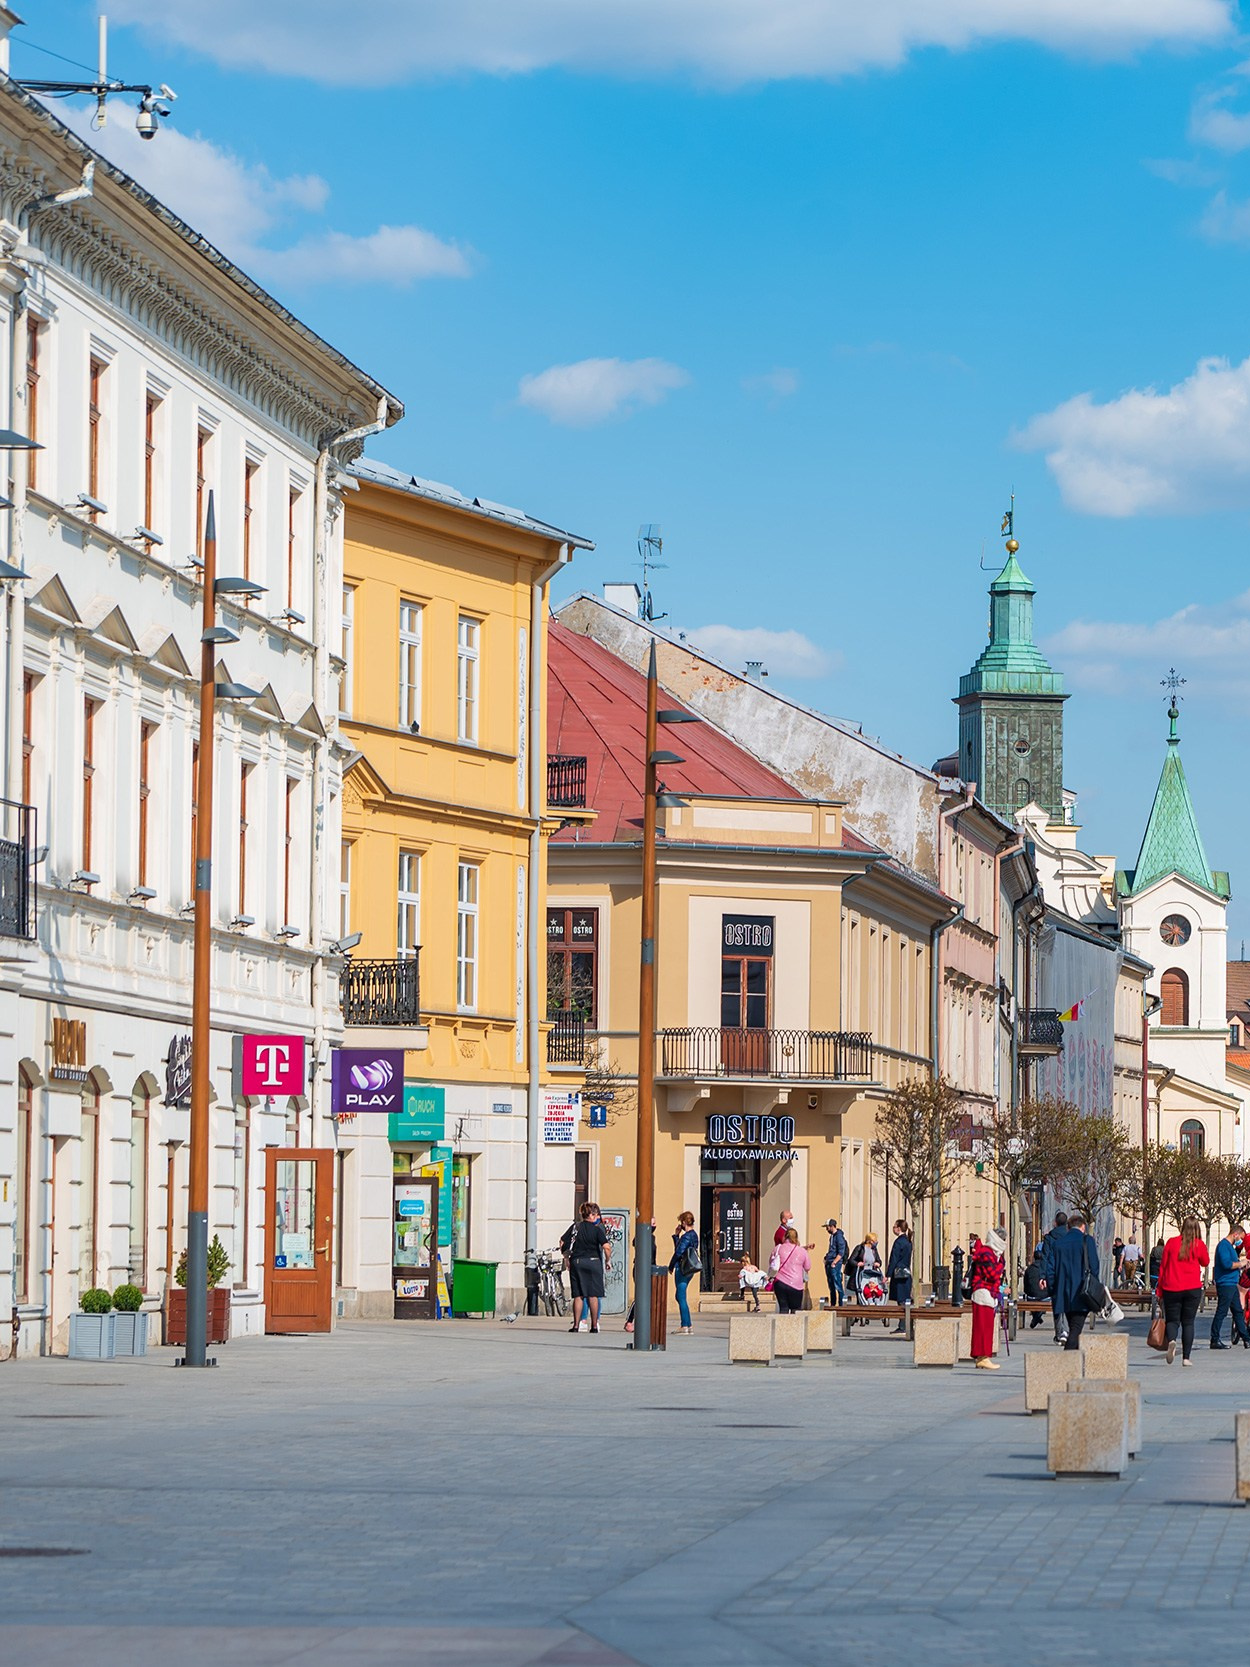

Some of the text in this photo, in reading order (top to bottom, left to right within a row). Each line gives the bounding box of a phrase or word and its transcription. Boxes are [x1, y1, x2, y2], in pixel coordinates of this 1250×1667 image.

[547, 926, 564, 934] STRO
[573, 926, 593, 934] OSTRO
[725, 923, 772, 947] OSTRO
[255, 1045, 290, 1086] T
[346, 1094, 396, 1106] PLAY
[417, 1100, 435, 1113] RUCH
[594, 1107, 602, 1121] 1
[709, 1114, 795, 1145] OSTRO
[704, 1148, 799, 1160] KLUBOKAWIARNIA
[726, 1209, 744, 1218] OSTRO
[403, 1285, 419, 1294] LOTTO
